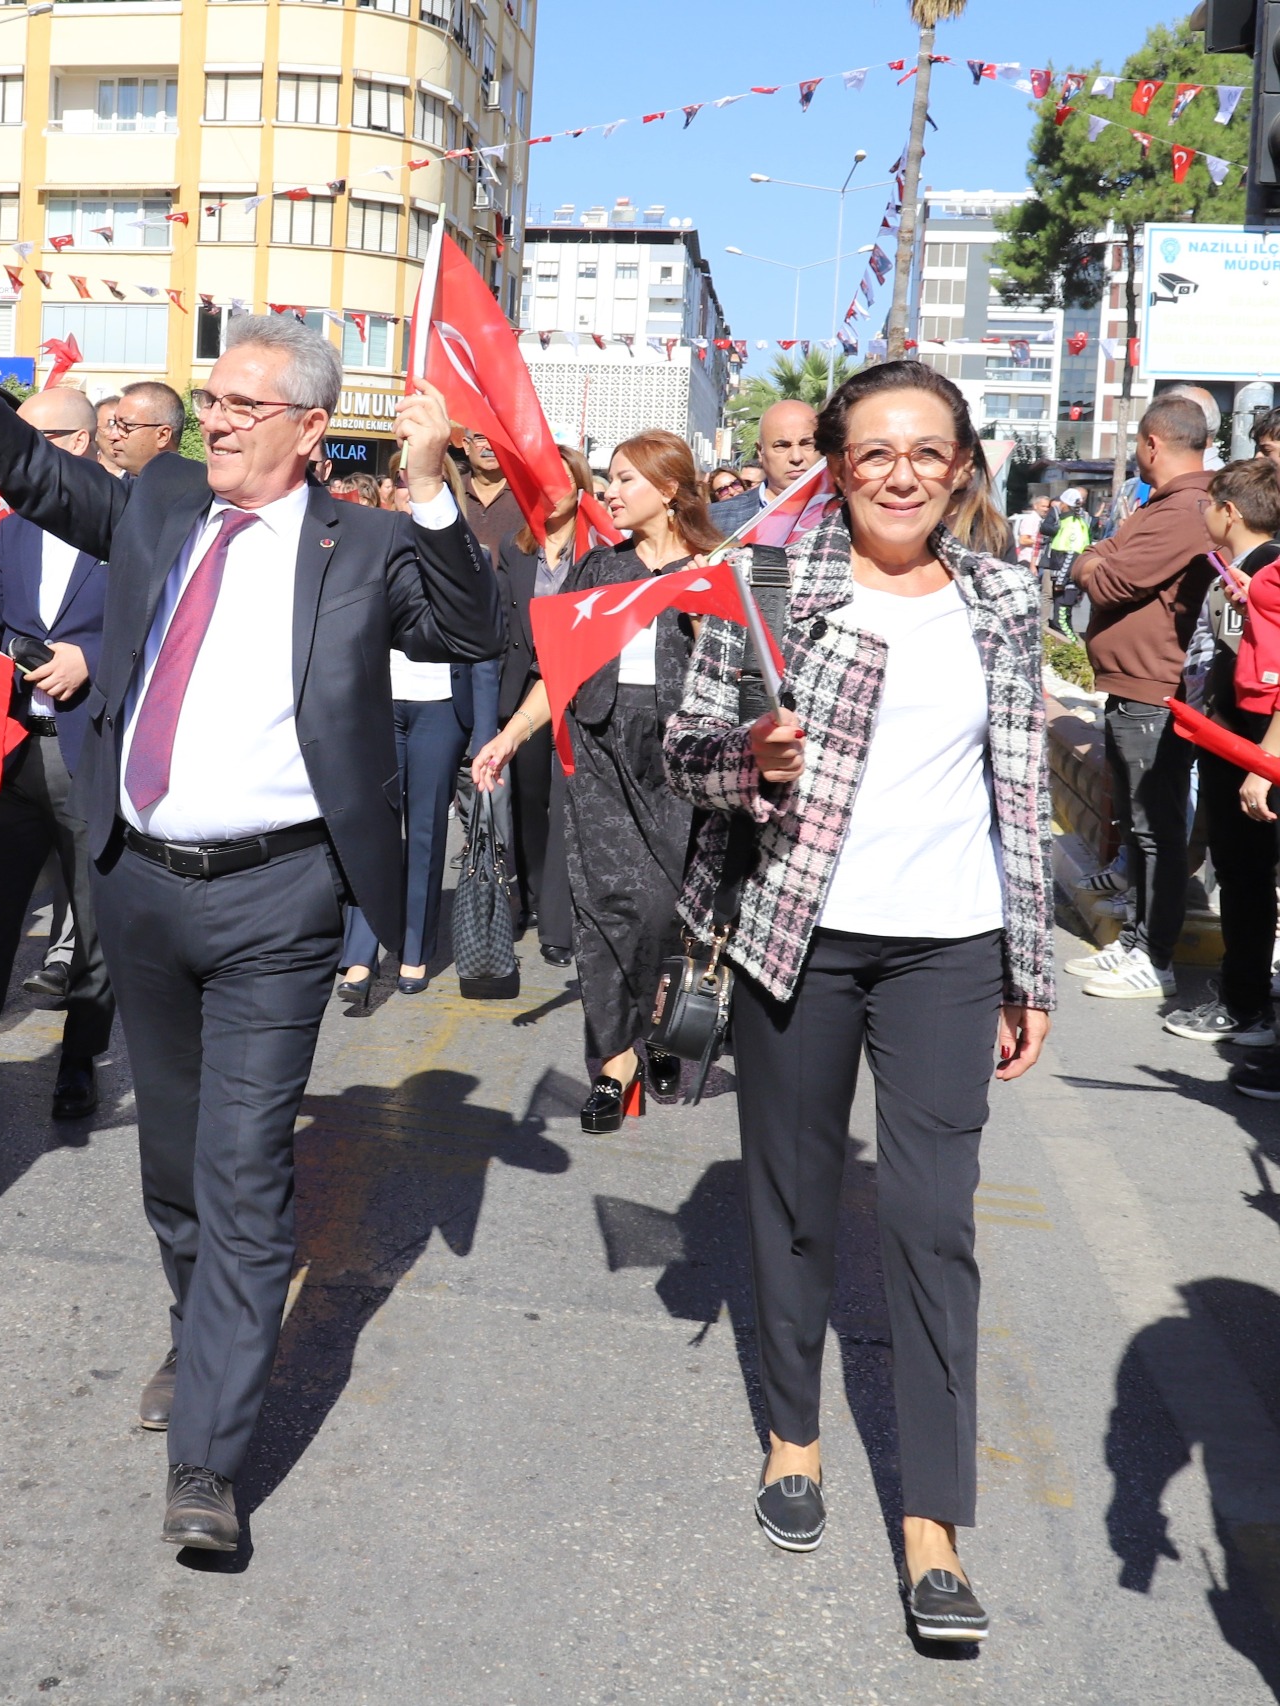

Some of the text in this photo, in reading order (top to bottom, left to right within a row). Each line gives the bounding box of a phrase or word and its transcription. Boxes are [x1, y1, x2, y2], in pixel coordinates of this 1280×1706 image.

[1188, 240, 1279, 256] NAZİLLİ İLÇ
[1224, 256, 1280, 271] MÜDÜR
[334, 391, 405, 417] UMUN
[329, 418, 365, 429] RABZON
